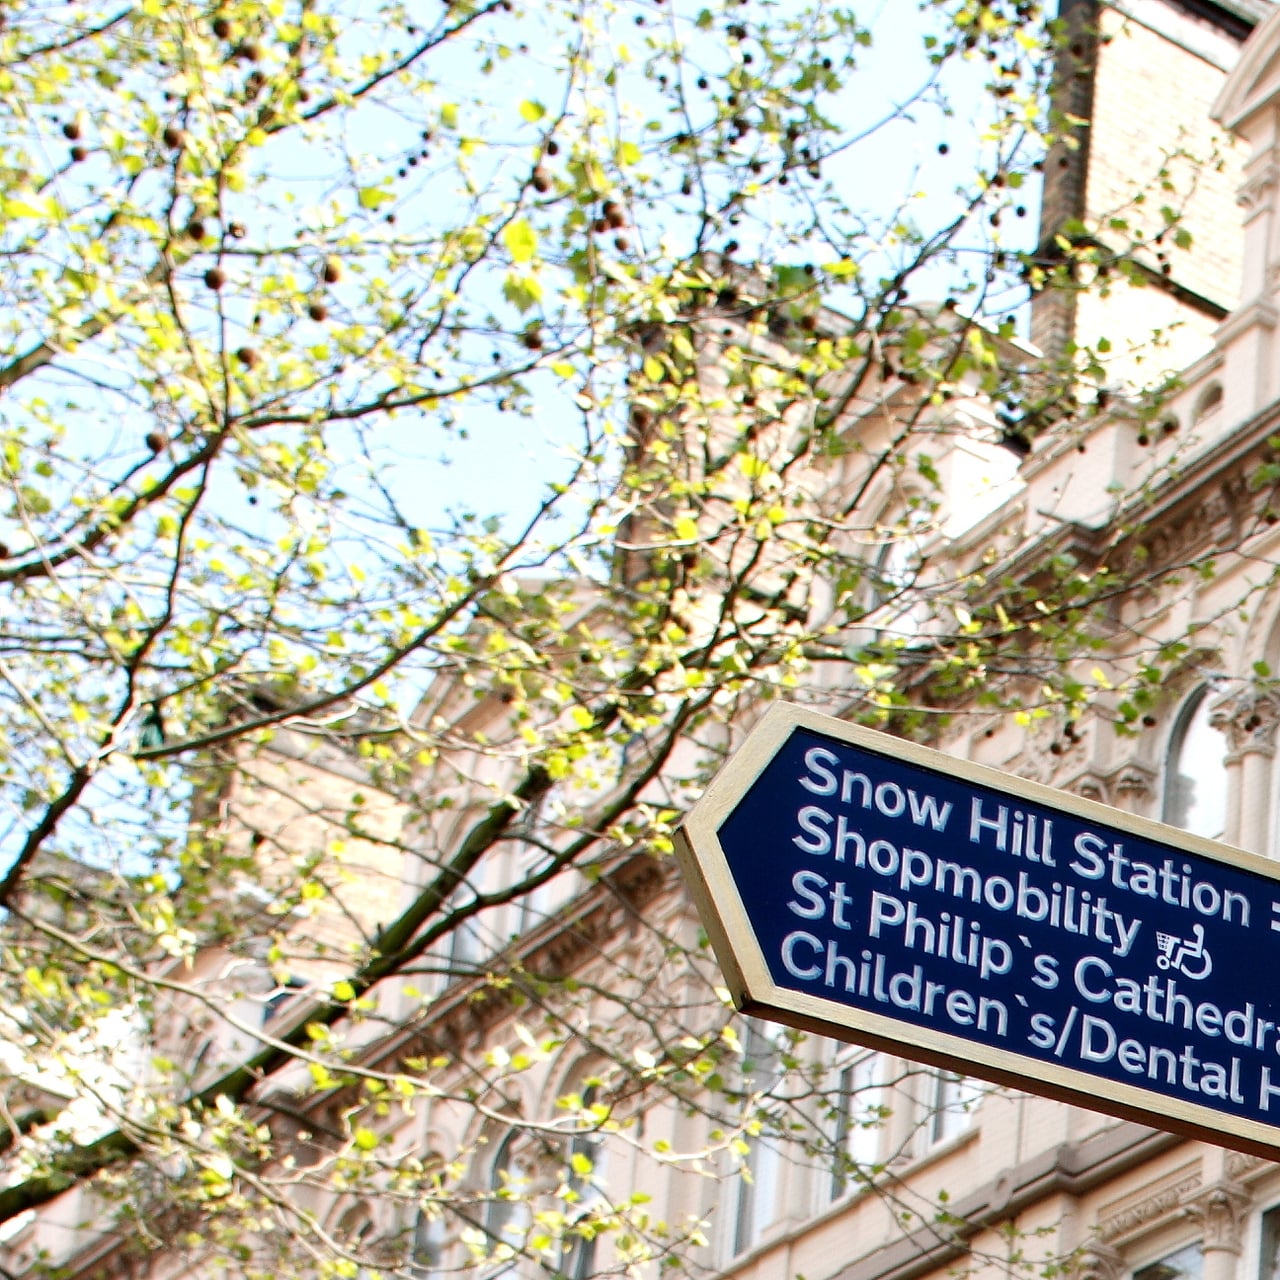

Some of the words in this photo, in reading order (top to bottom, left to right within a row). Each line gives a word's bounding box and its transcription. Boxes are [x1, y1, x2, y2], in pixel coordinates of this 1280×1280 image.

[787, 870, 853, 929] St
[792, 806, 1142, 956] Shopmobility
[799, 747, 953, 832] Snow
[969, 798, 1056, 867] Hill
[1069, 831, 1250, 928] Station
